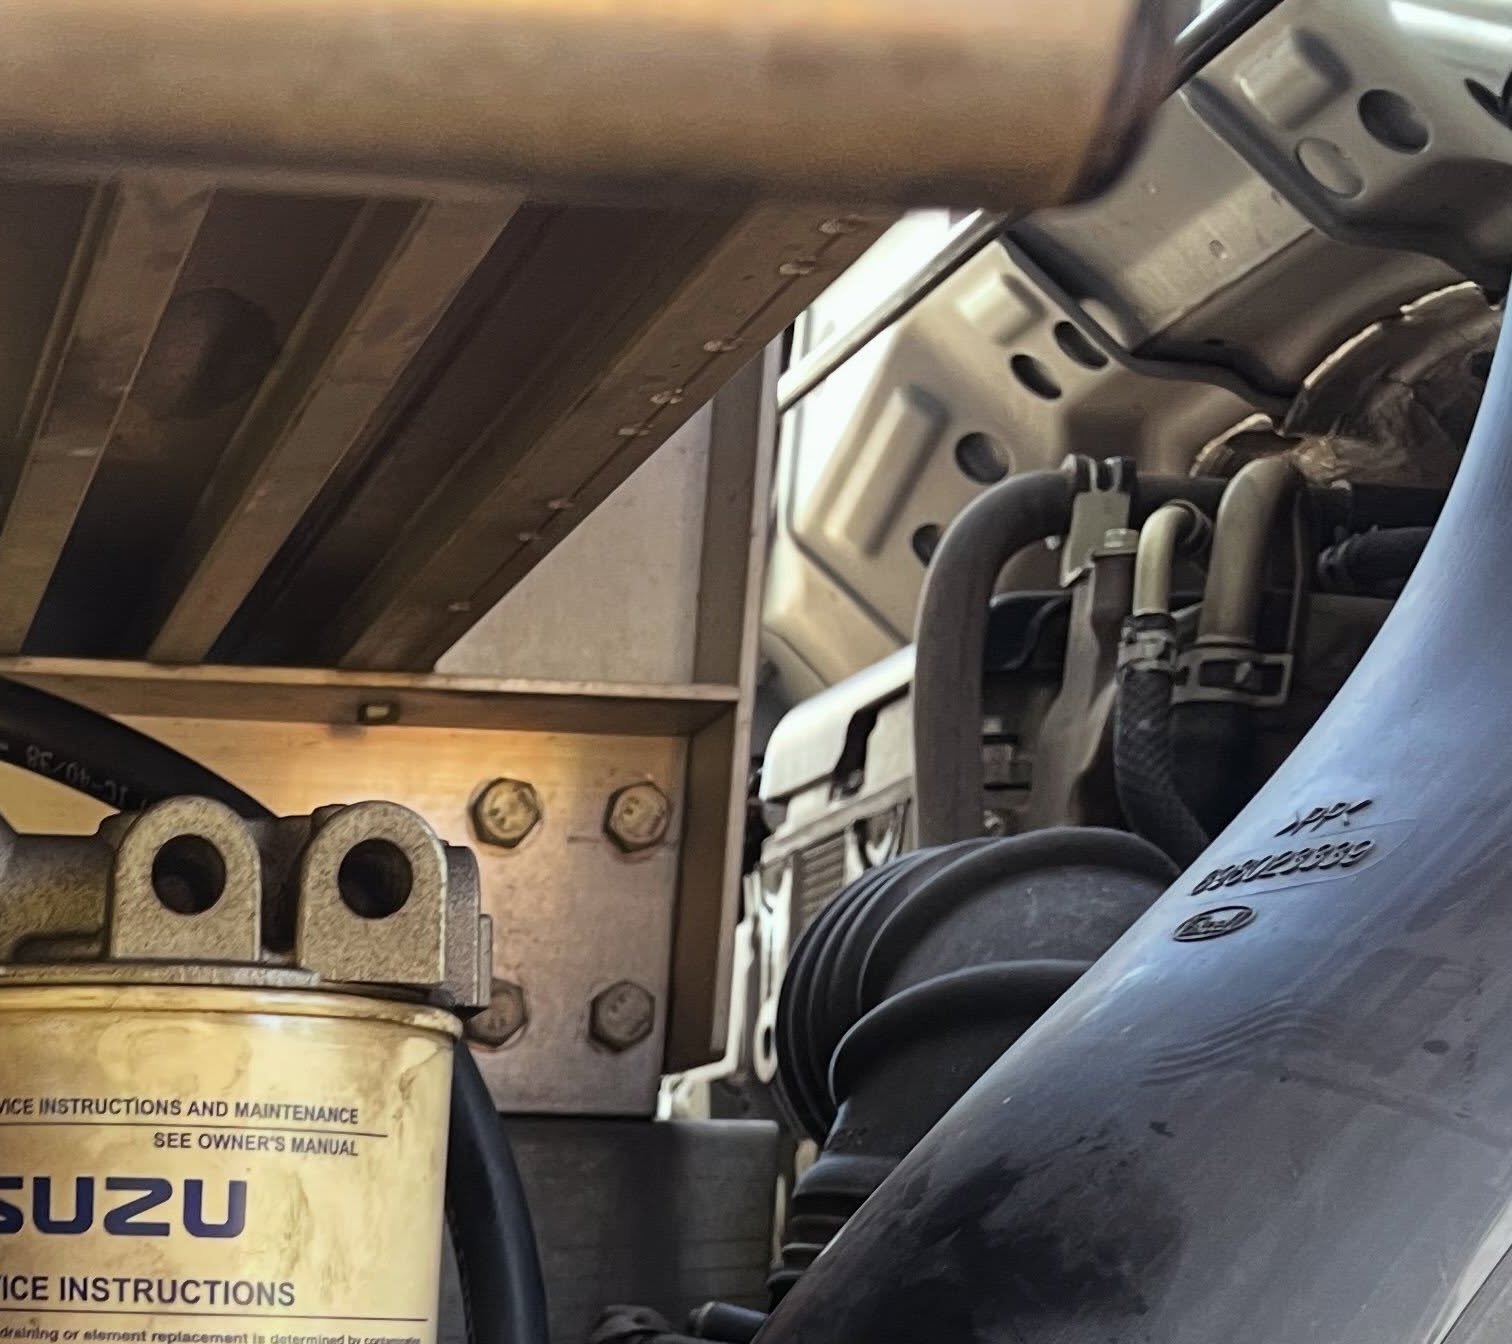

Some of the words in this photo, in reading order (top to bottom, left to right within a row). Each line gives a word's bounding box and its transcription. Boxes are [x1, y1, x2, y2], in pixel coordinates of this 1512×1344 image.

[39, 1096, 182, 1117] INSTRUCTIONS
[187, 1100, 229, 1118] AND
[234, 1101, 359, 1125] MAINTENANCE
[153, 1132, 192, 1149] SEE
[198, 1133, 286, 1153] OWNER'S
[291, 1137, 359, 1157] MANUAL
[59, 1276, 297, 1307] INSTRUCTIONS
[0, 1326, 60, 1343] draining
[62, 1329, 79, 1342] or
[83, 1328, 148, 1343] element
